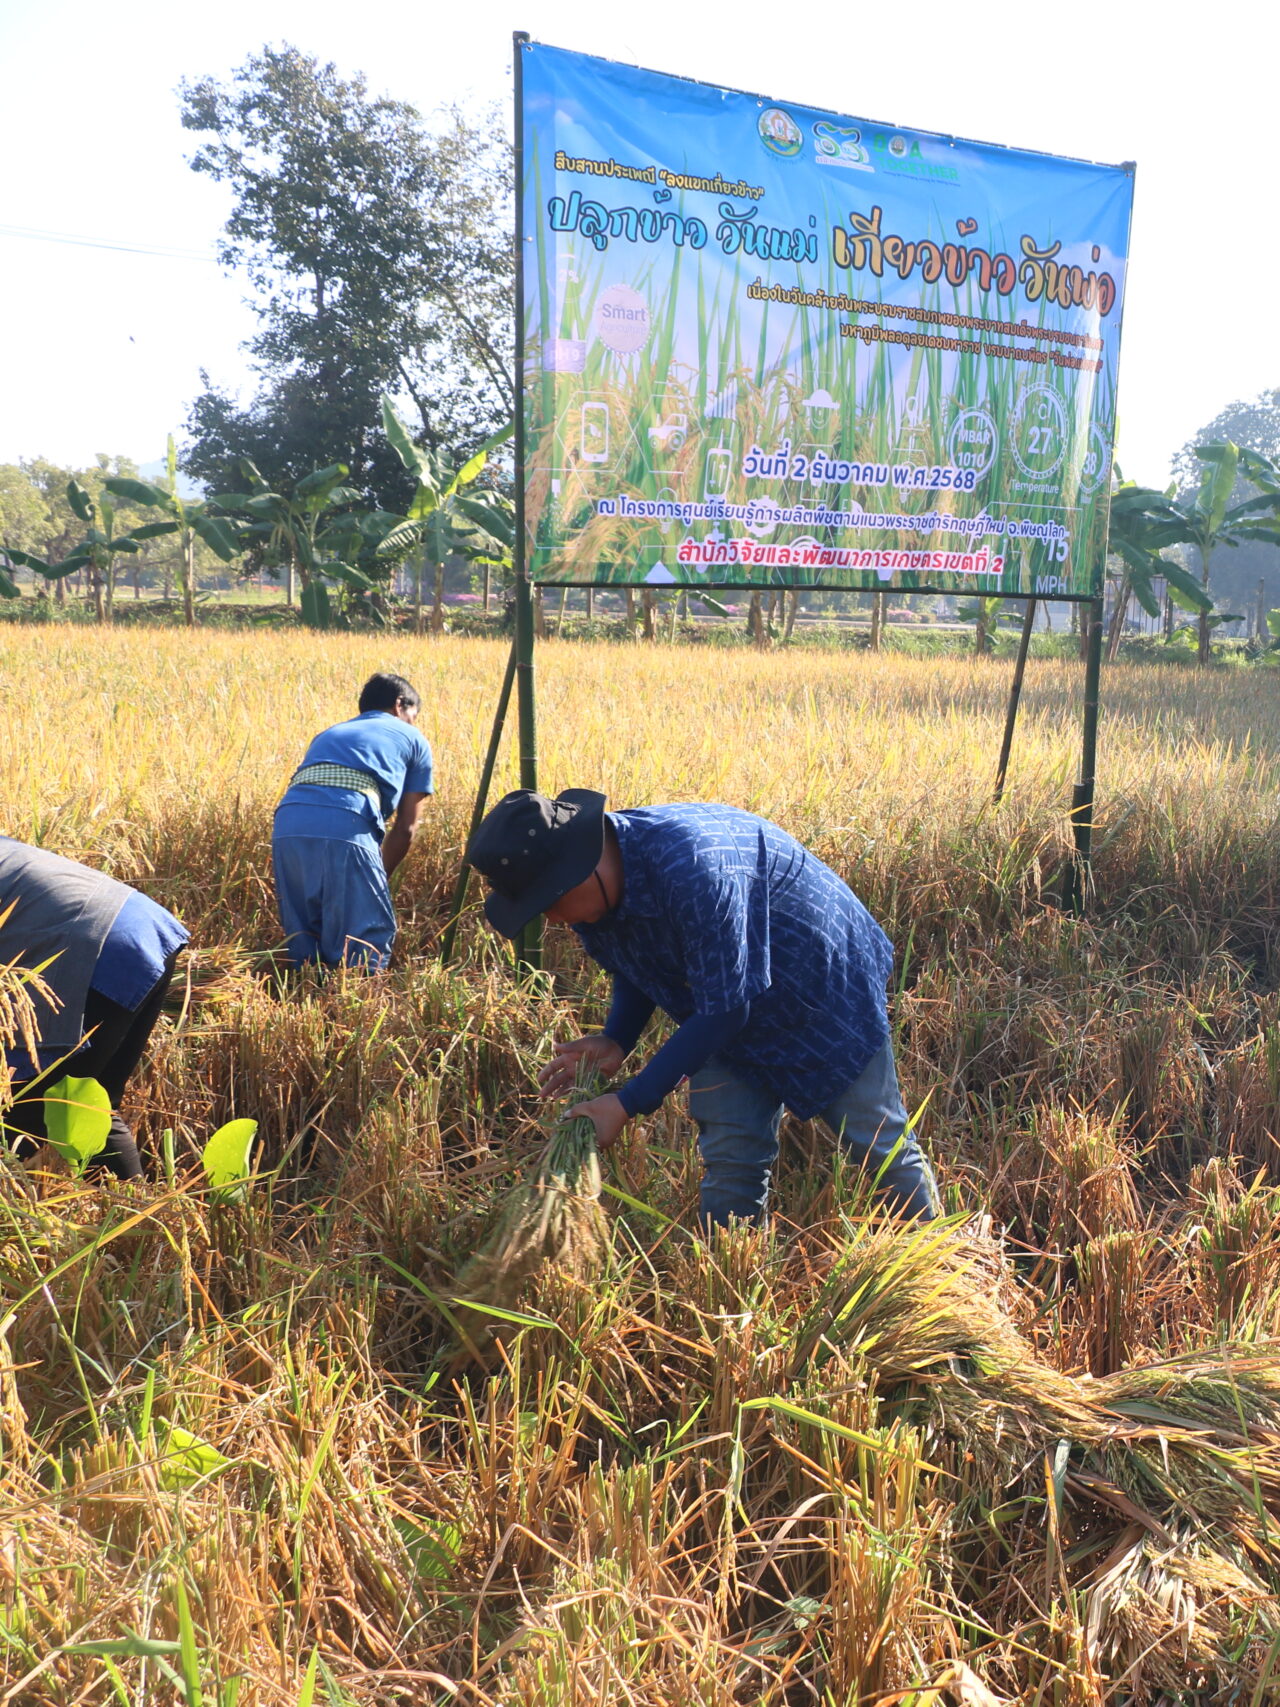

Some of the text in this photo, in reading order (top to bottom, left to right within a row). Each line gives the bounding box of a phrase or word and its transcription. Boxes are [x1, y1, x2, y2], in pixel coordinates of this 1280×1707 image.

[554, 150, 656, 184] สืบสานประเพณี
[548, 190, 1116, 317] ปลูกข้าว วันแม่ เกี่ยวข้าว วันพ่อ
[602, 303, 647, 322] Smart
[1028, 427, 1052, 455] 27
[744, 440, 976, 490] วันที่ 2 ธันวาคม พ.ศ.2568
[1011, 480, 1059, 494] Temperature
[1008, 521, 1065, 544] จ.พิษณุโลก
[1036, 575, 1067, 594] MPH
